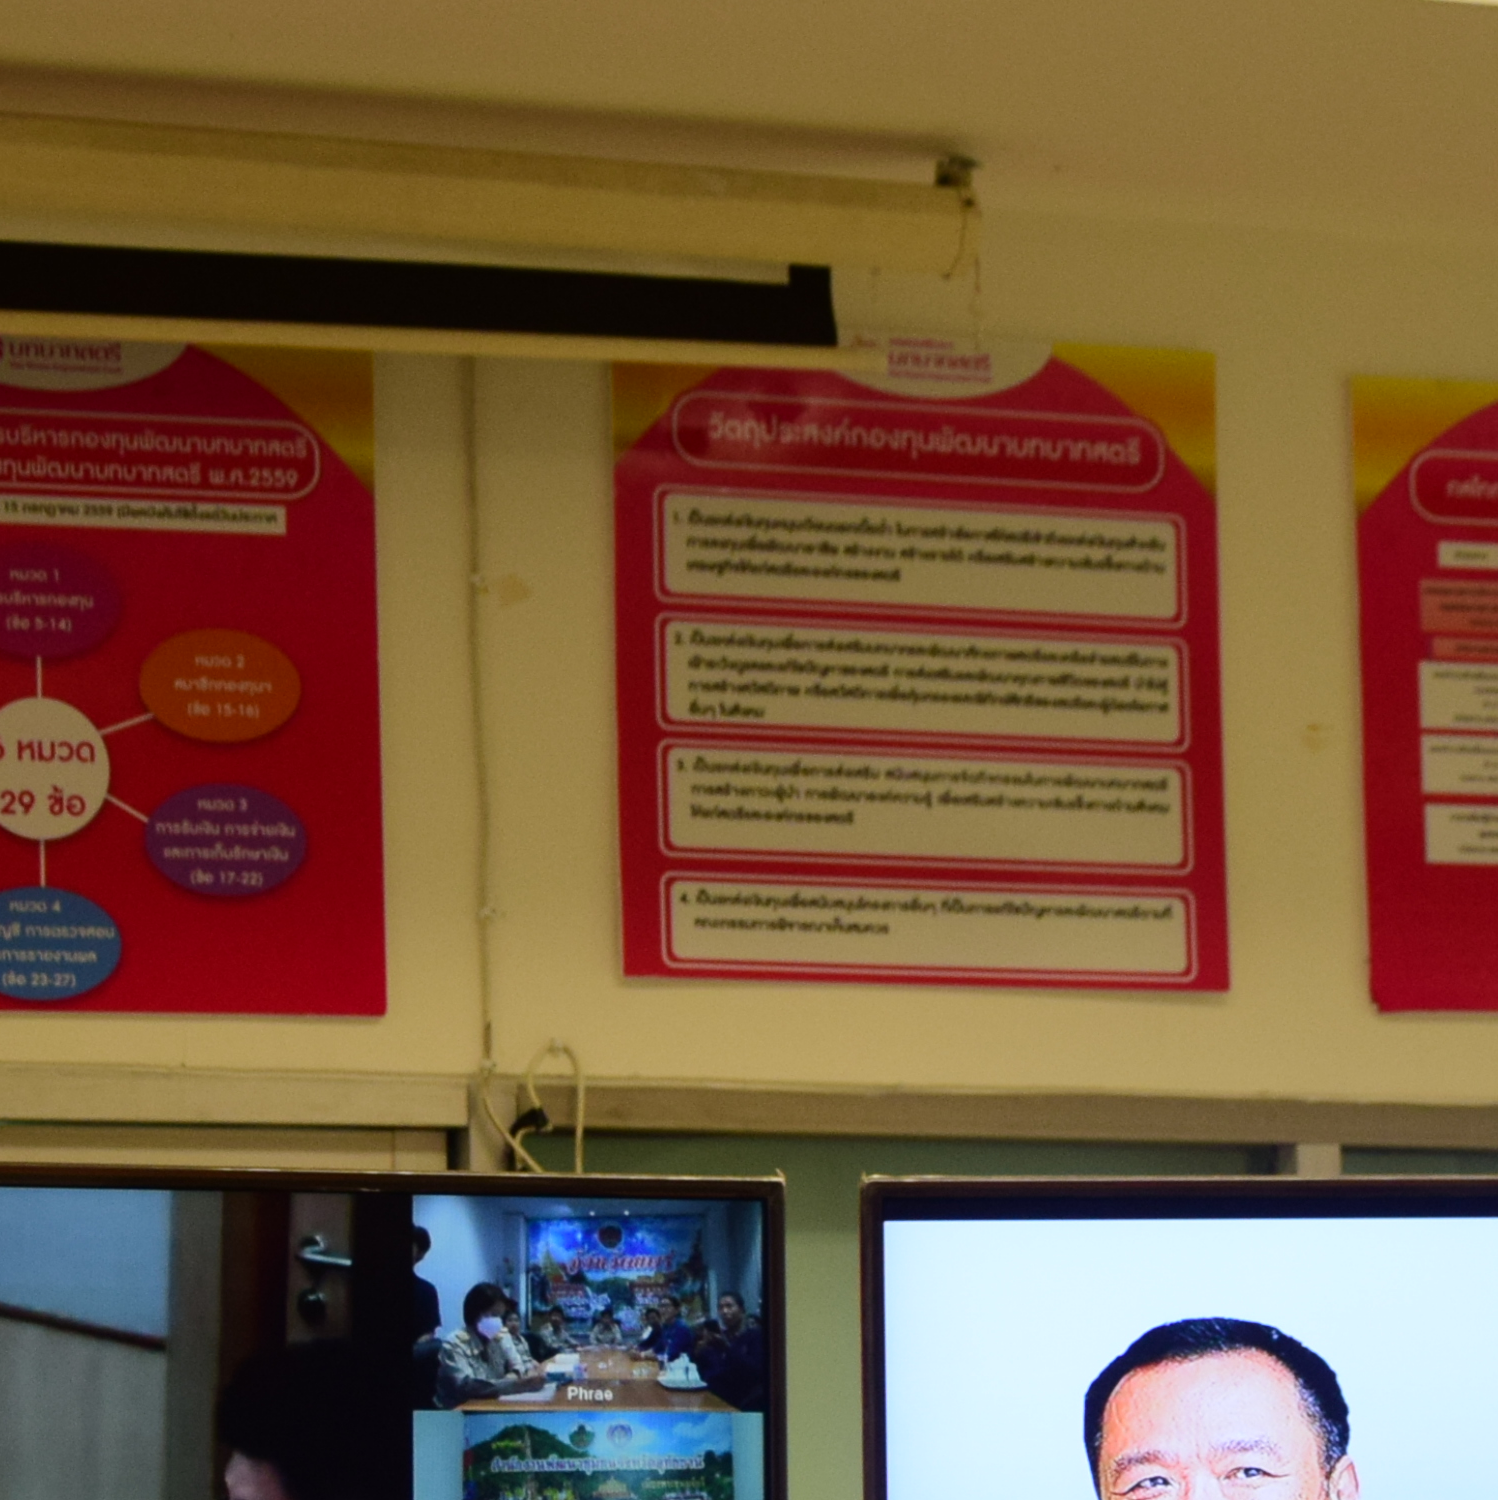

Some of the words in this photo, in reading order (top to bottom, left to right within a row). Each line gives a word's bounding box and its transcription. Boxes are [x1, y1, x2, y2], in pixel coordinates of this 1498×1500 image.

[17, 738, 96, 764] หมวด
[0, 790, 34, 817] 29
[47, 786, 86, 818] ข้อ
[567, 1385, 614, 1402] Phrae
